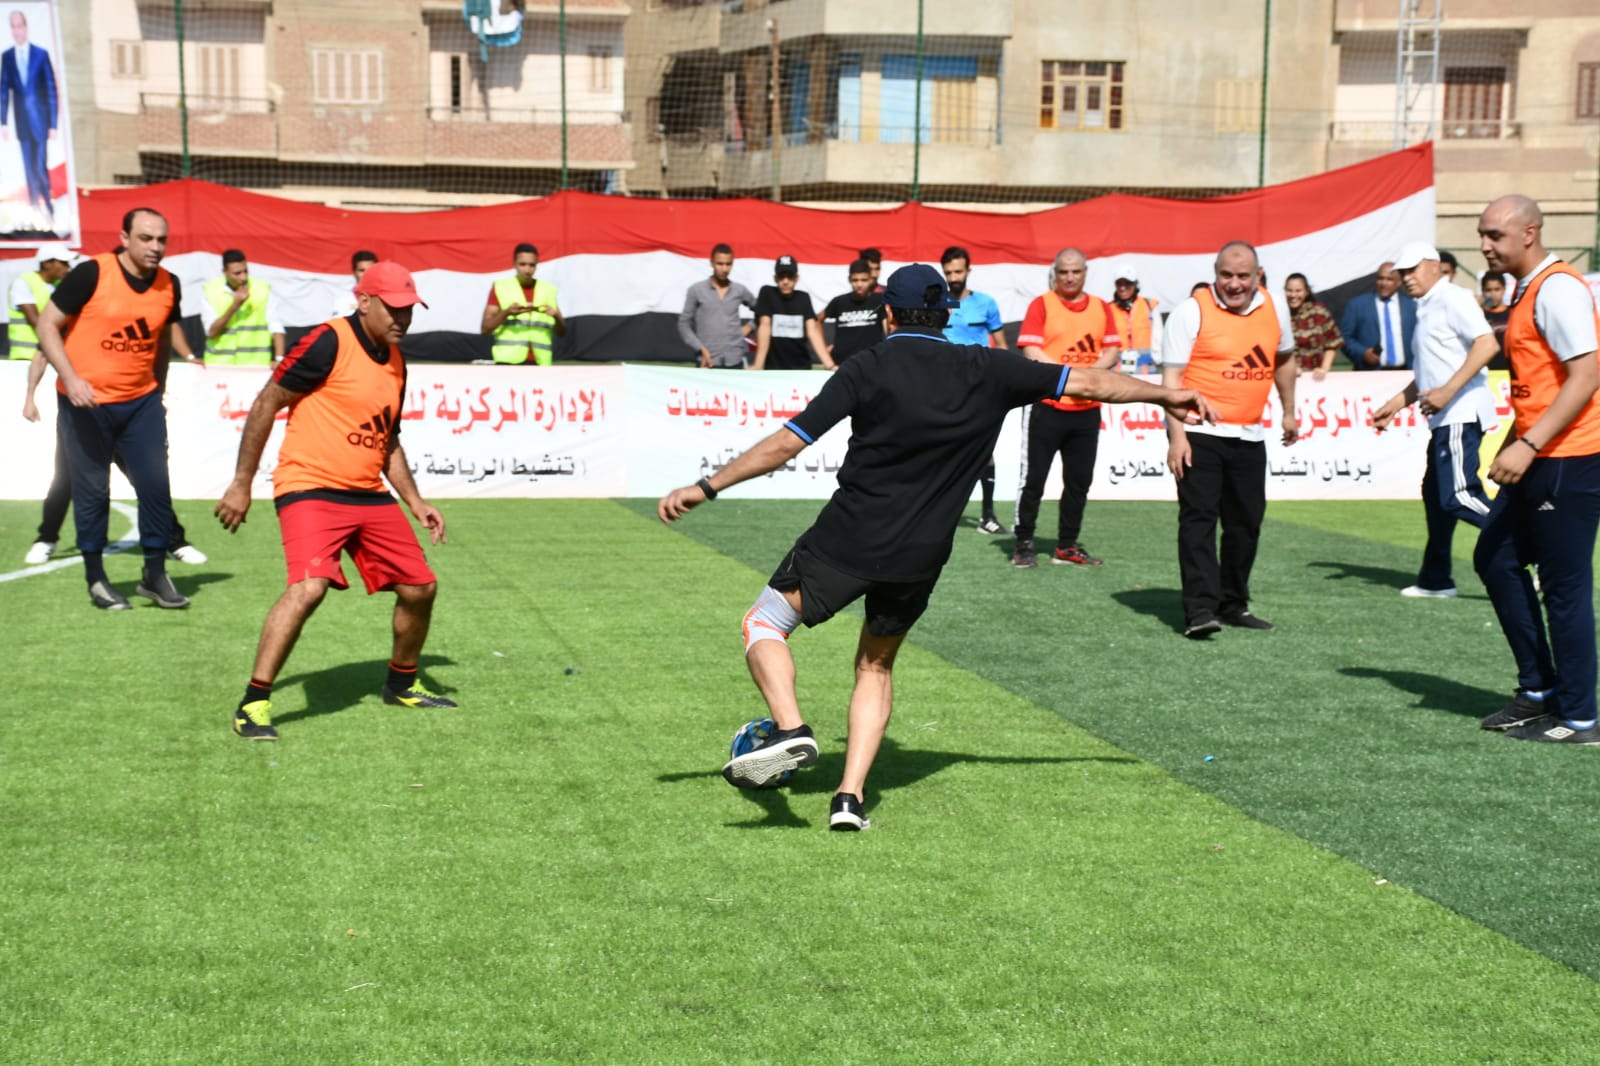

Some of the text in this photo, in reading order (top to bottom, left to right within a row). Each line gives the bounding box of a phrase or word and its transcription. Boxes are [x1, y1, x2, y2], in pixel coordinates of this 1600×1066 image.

[1222, 368, 1274, 381] adida
[433, 383, 527, 435] المركزية
[534, 388, 605, 432] الإدارة
[1268, 455, 1316, 482] الشبا
[1321, 459, 1372, 483] برلمان
